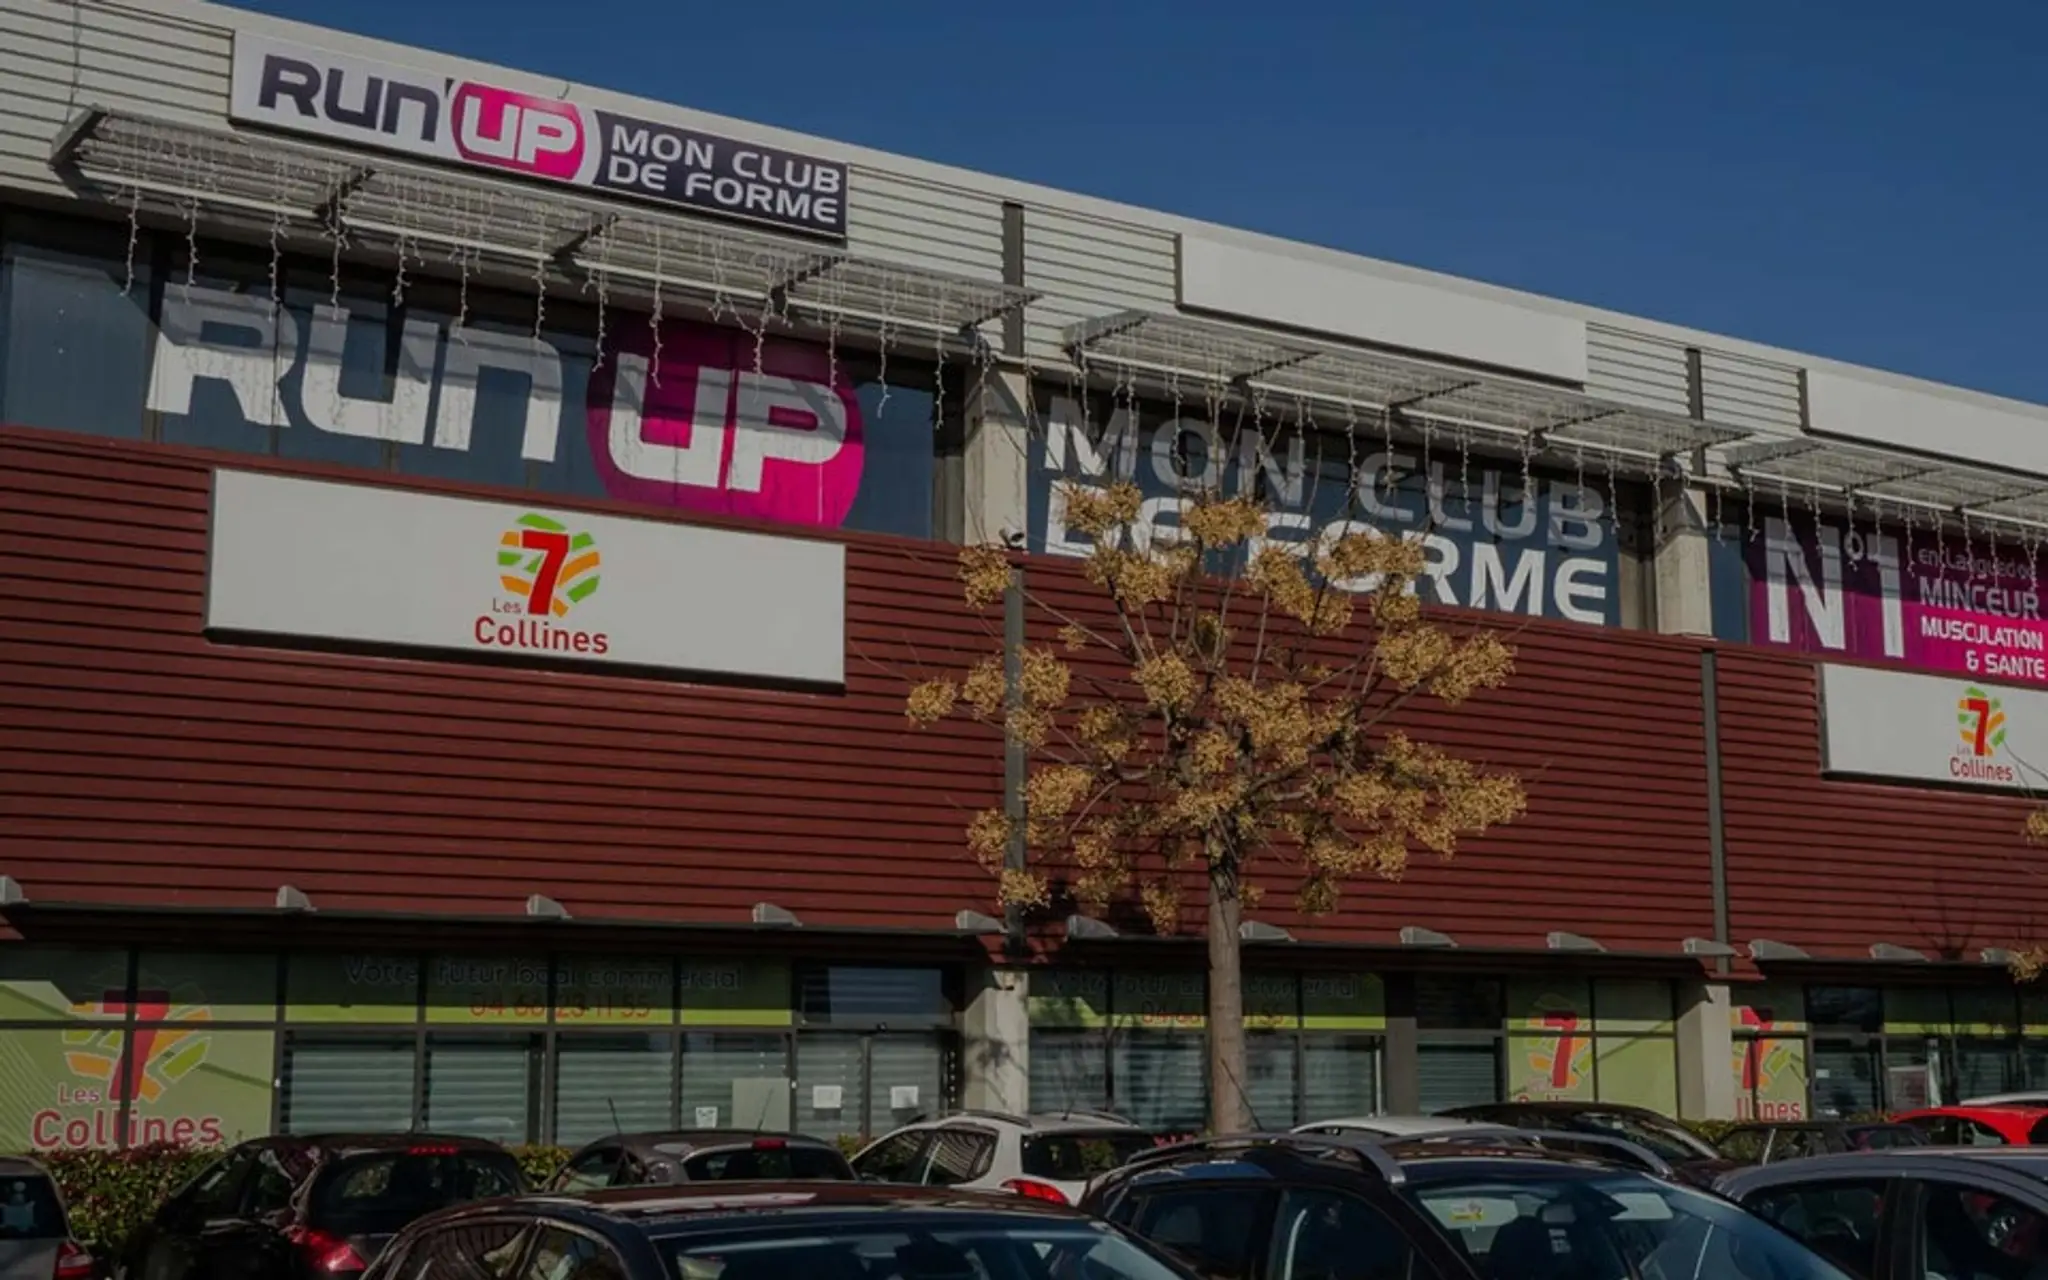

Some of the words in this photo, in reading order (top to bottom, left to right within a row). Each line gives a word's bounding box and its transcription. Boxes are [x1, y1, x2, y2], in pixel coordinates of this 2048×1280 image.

[460, 94, 578, 164] UP
[611, 124, 715, 170] MON
[731, 151, 840, 194] CLUB
[608, 155, 669, 192] DE
[685, 172, 839, 225] FORME
[607, 352, 847, 493] UP
[1044, 395, 1306, 507] MON
[1357, 449, 1606, 551] CLUB
[492, 598, 522, 614] Les
[521, 529, 570, 616] 7
[1920, 576, 2042, 622] MINCEUR
[475, 615, 609, 655] Collines
[1920, 615, 2045, 652] MUSCULATION
[1965, 649, 1980, 672] &
[1984, 652, 2047, 679] SANTE
[1967, 698, 1990, 757] 7
[1949, 756, 2014, 782] Collines
[58, 1083, 100, 1104] Les
[103, 990, 172, 1101] 7
[1543, 1010, 1577, 1089] 7
[32, 1107, 224, 1150] Collines
